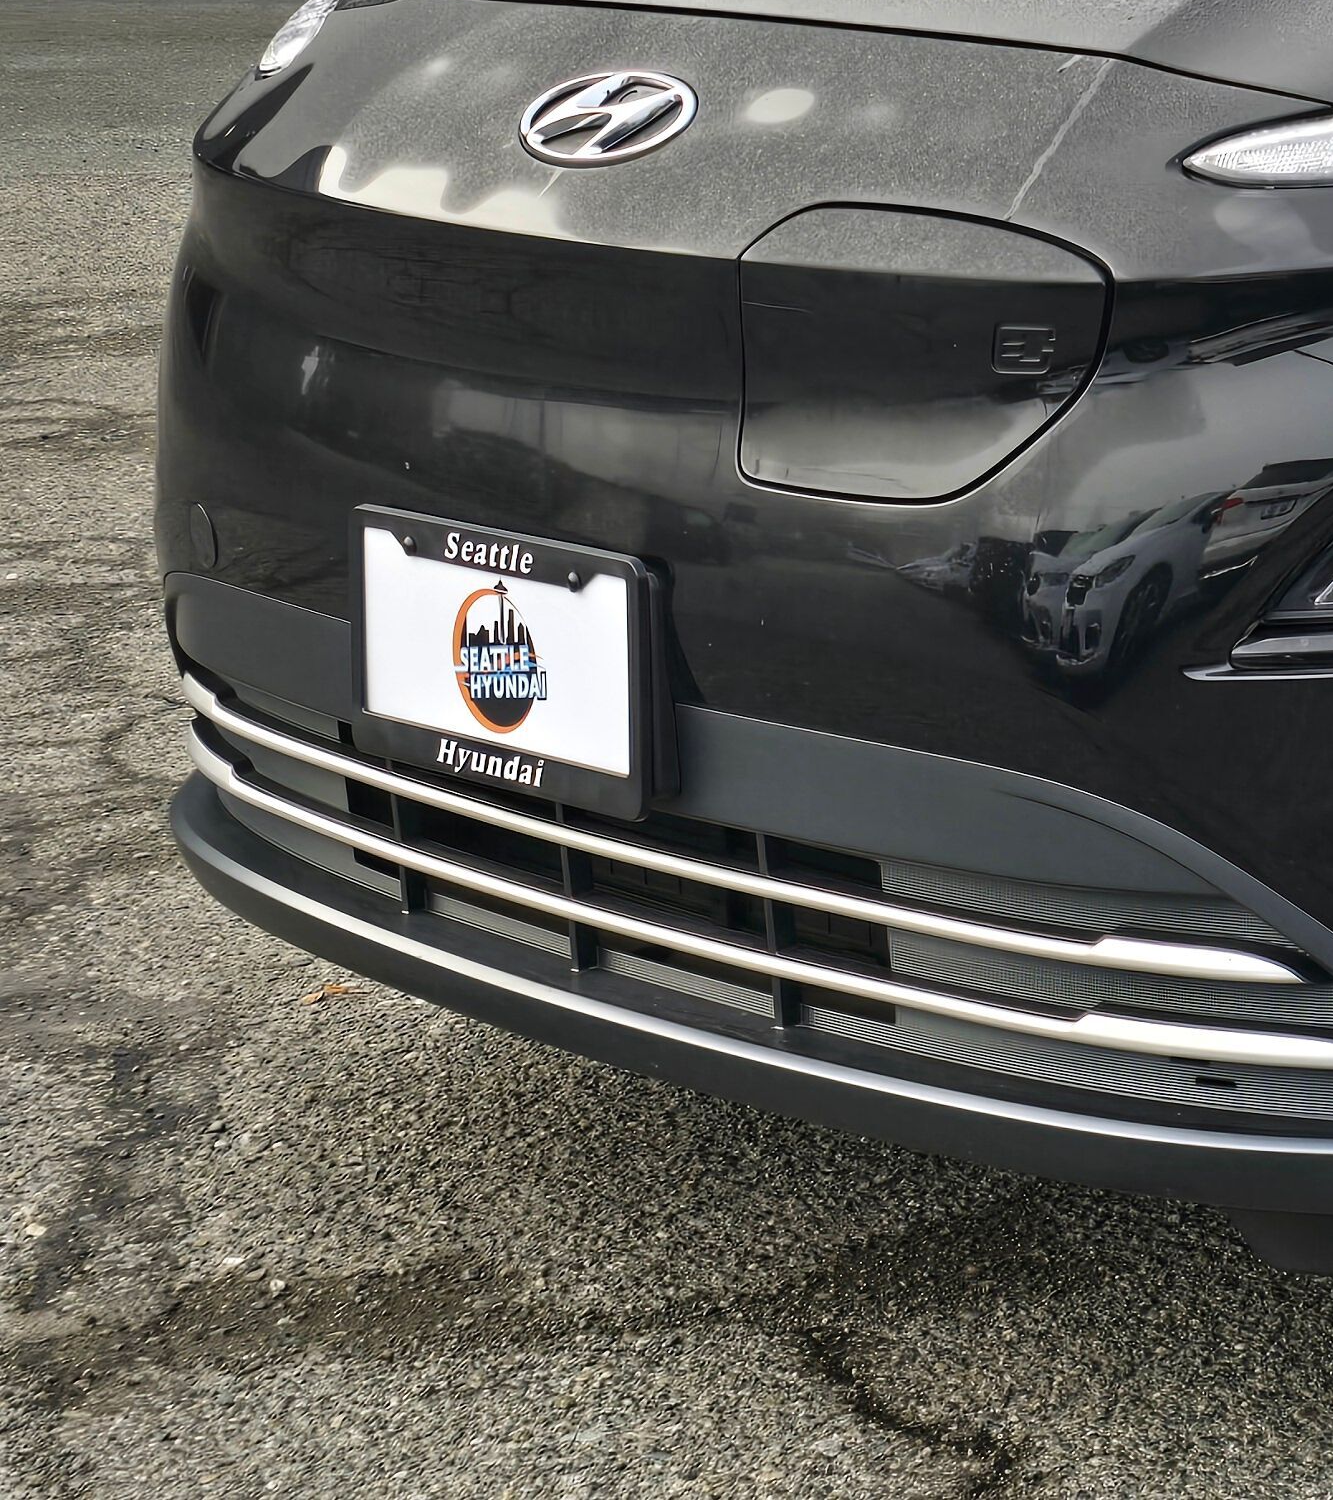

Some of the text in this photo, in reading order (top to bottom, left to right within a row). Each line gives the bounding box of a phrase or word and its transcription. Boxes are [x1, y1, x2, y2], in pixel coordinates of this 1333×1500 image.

[444, 532, 534, 575] Seattle
[459, 645, 531, 673] SEATTLE
[470, 672, 547, 700] HYUNDAI
[436, 738, 545, 788] Hyundai
